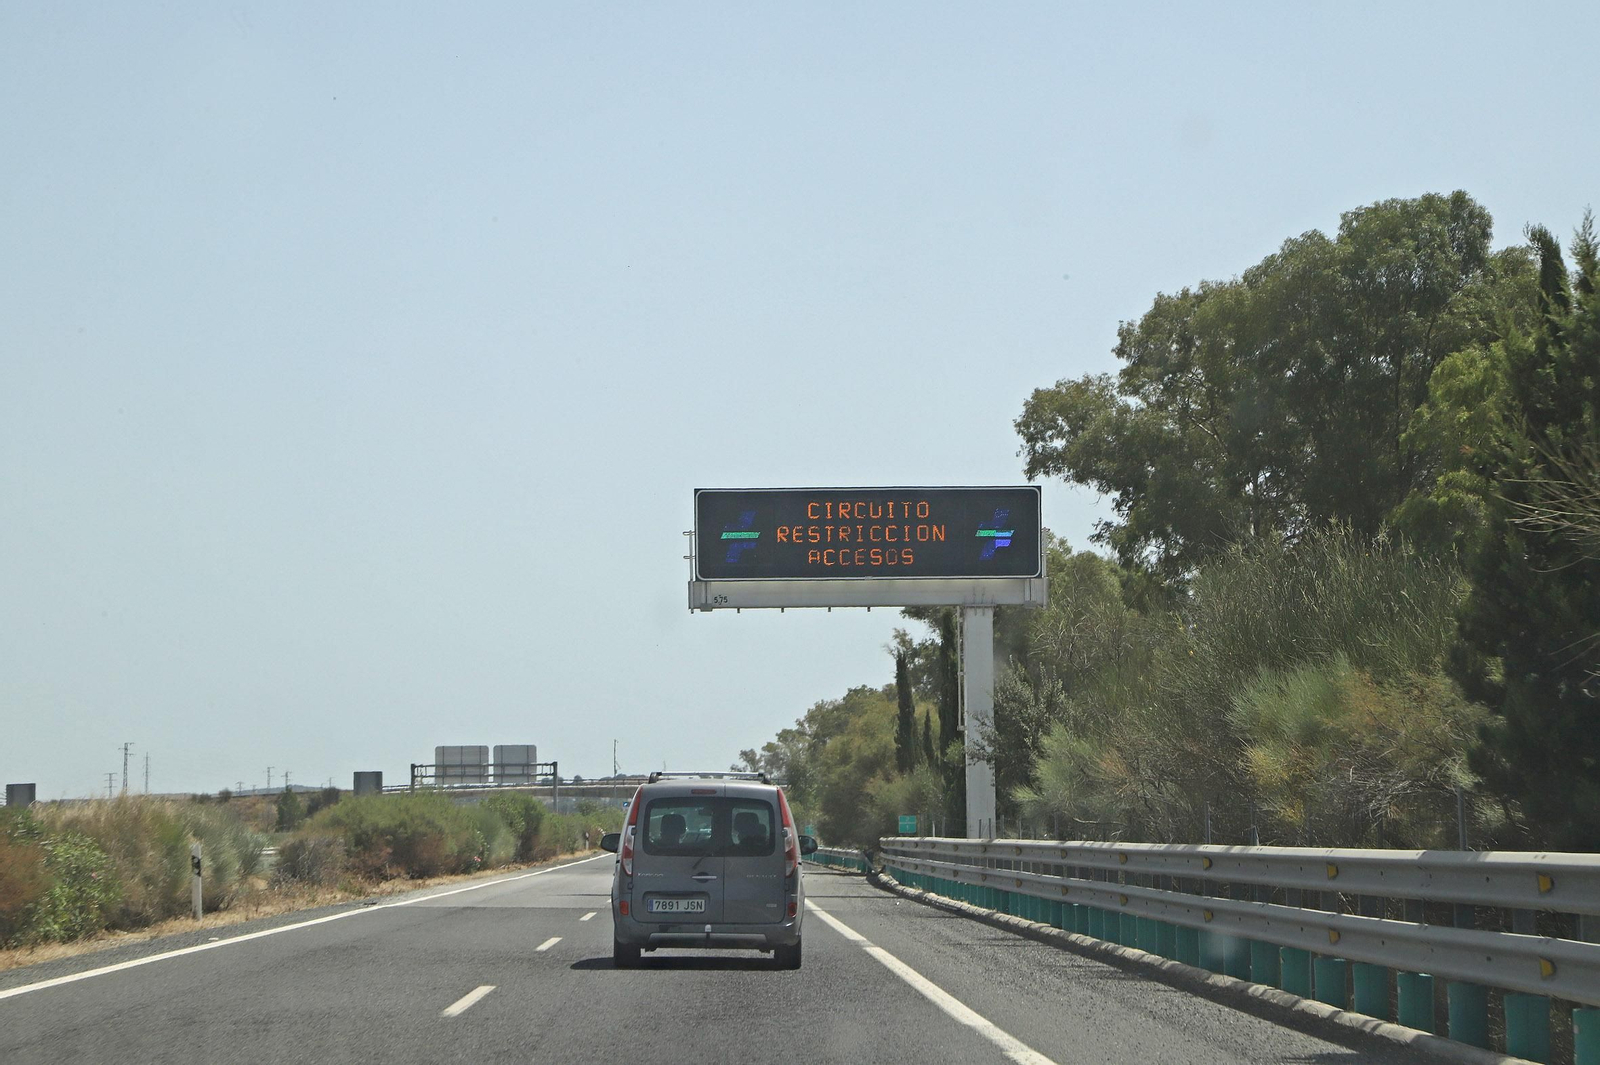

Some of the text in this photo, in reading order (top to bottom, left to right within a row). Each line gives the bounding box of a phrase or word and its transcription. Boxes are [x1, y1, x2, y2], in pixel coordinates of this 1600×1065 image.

[807, 501, 930, 519] CIRCUITO
[776, 525, 946, 543] RESTRICCION
[808, 548, 914, 566] ACCESOS
[655, 901, 703, 911] 7891 JSN
